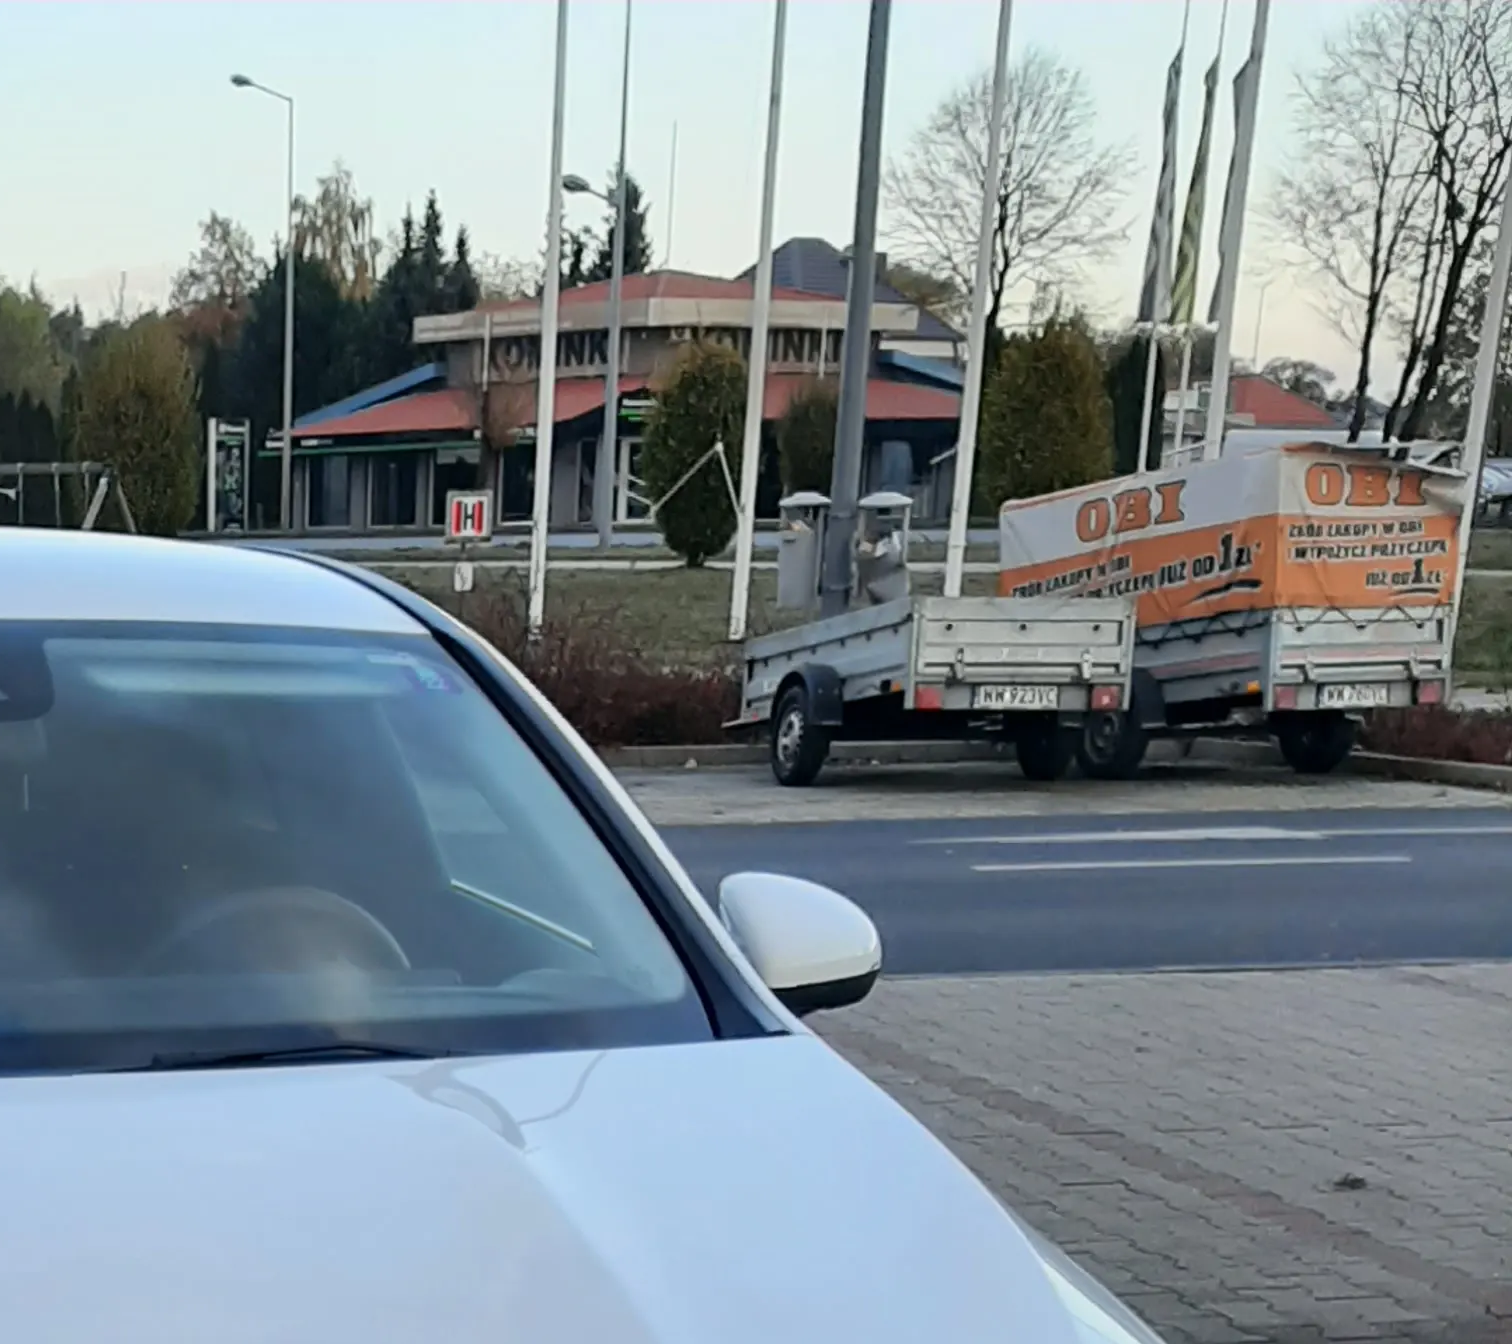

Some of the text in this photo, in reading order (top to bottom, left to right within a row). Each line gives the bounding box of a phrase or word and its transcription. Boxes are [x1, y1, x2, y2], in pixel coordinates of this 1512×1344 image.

[1305, 462, 1426, 506] OBI
[1076, 479, 1186, 542] OBI
[1382, 521, 1395, 536] W
[1192, 555, 1215, 578] OD
[1218, 532, 1233, 572] 1
[1411, 558, 1424, 584] 1
